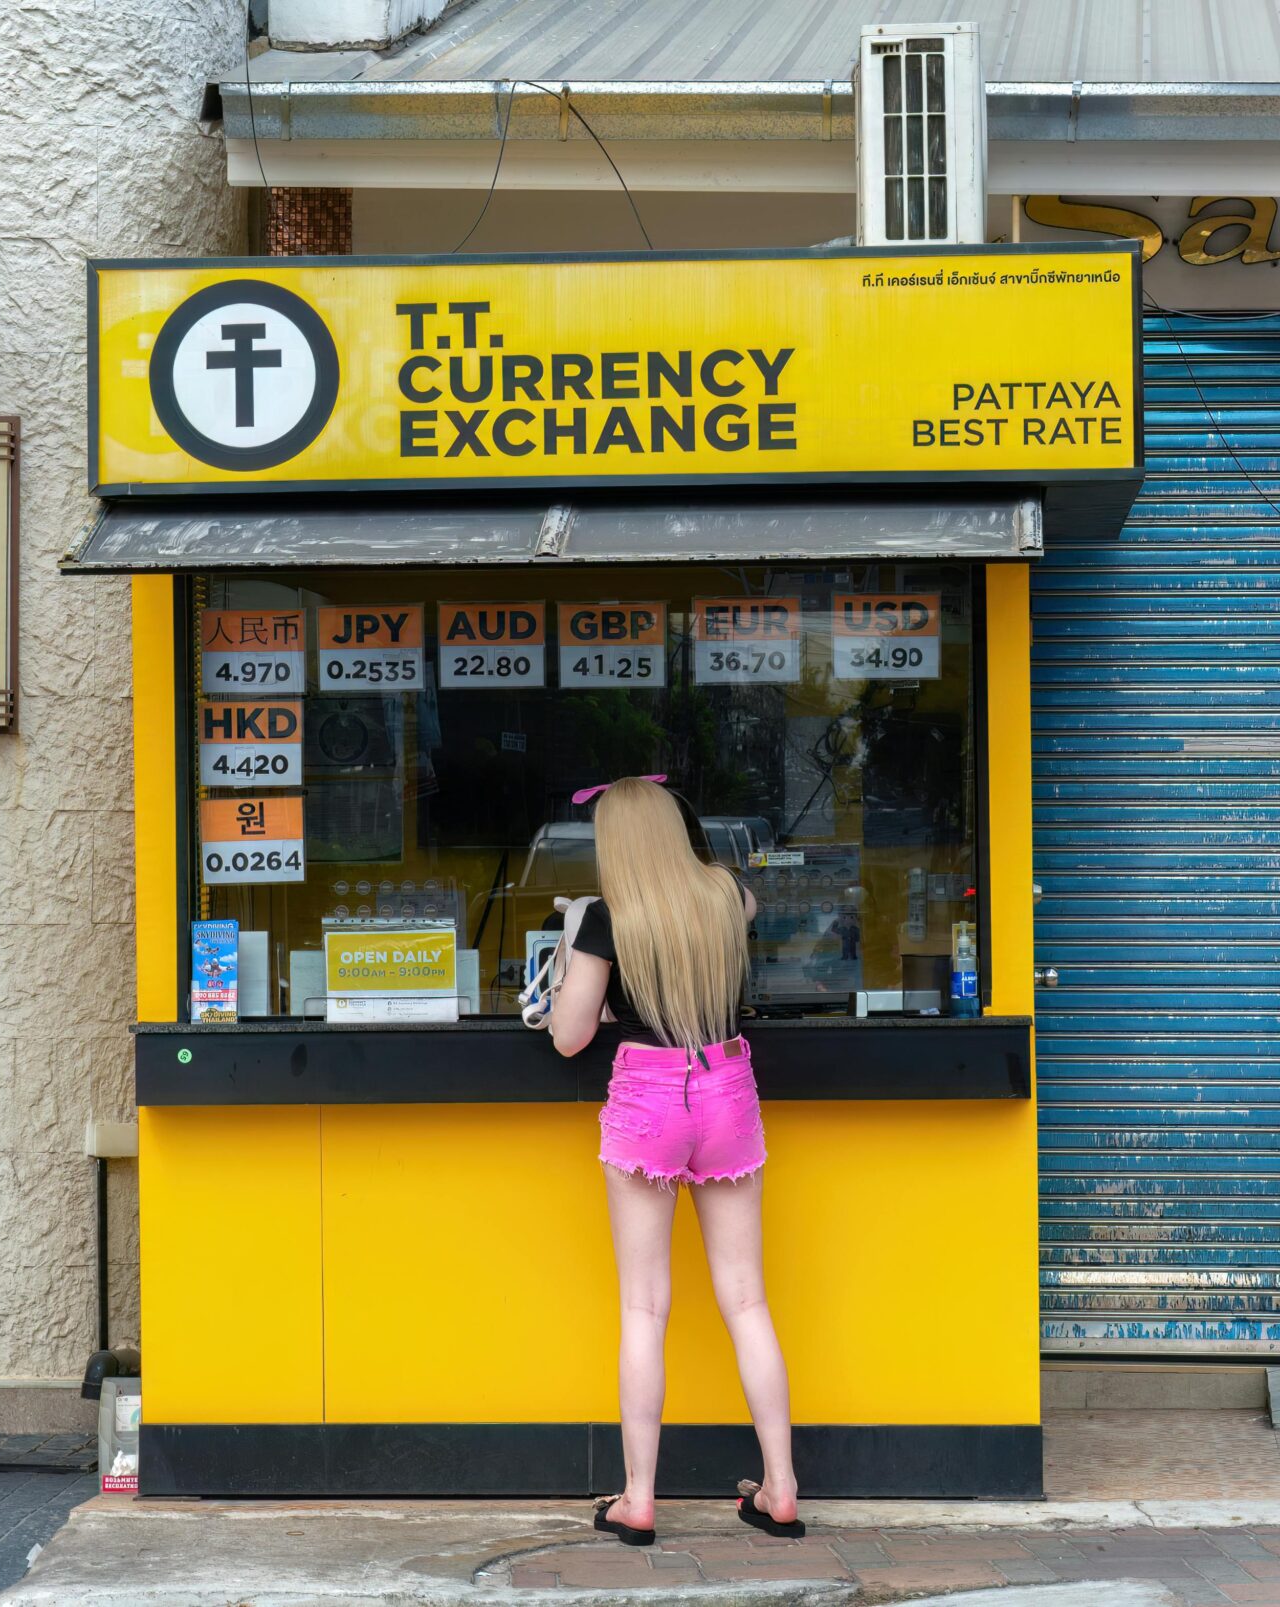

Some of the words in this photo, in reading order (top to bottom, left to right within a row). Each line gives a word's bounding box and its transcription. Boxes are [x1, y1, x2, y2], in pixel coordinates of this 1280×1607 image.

[396, 301, 504, 350] T.T.
[398, 348, 796, 403] CURRENCY
[954, 381, 1121, 411] PATTAYA
[400, 403, 797, 458] EXCHANGE
[913, 419, 1008, 447] BEST
[1024, 418, 1122, 445] RATE
[206, 615, 300, 646] 人民币
[333, 613, 409, 644] JPY
[446, 611, 537, 641] AUD
[570, 611, 655, 640] GBP
[705, 605, 789, 636] EUR
[844, 601, 929, 631] USD
[216, 661, 291, 683] 4.970
[327, 659, 416, 683] 0.2535
[453, 655, 531, 677] 22.80
[573, 654, 652, 679] 41.25
[709, 651, 786, 674] 36.70
[850, 647, 923, 669] 34.90
[205, 708, 297, 739] HKD
[212, 754, 289, 777] 4.420
[236, 802, 266, 836] 원
[206, 850, 302, 873] 0.0264
[196, 930, 235, 939] SKYDIVING
[341, 951, 387, 964] OPEN
[392, 949, 442, 963] DAILY
[338, 967, 386, 978] 9:00AM
[399, 966, 446, 977] 9:00PM
